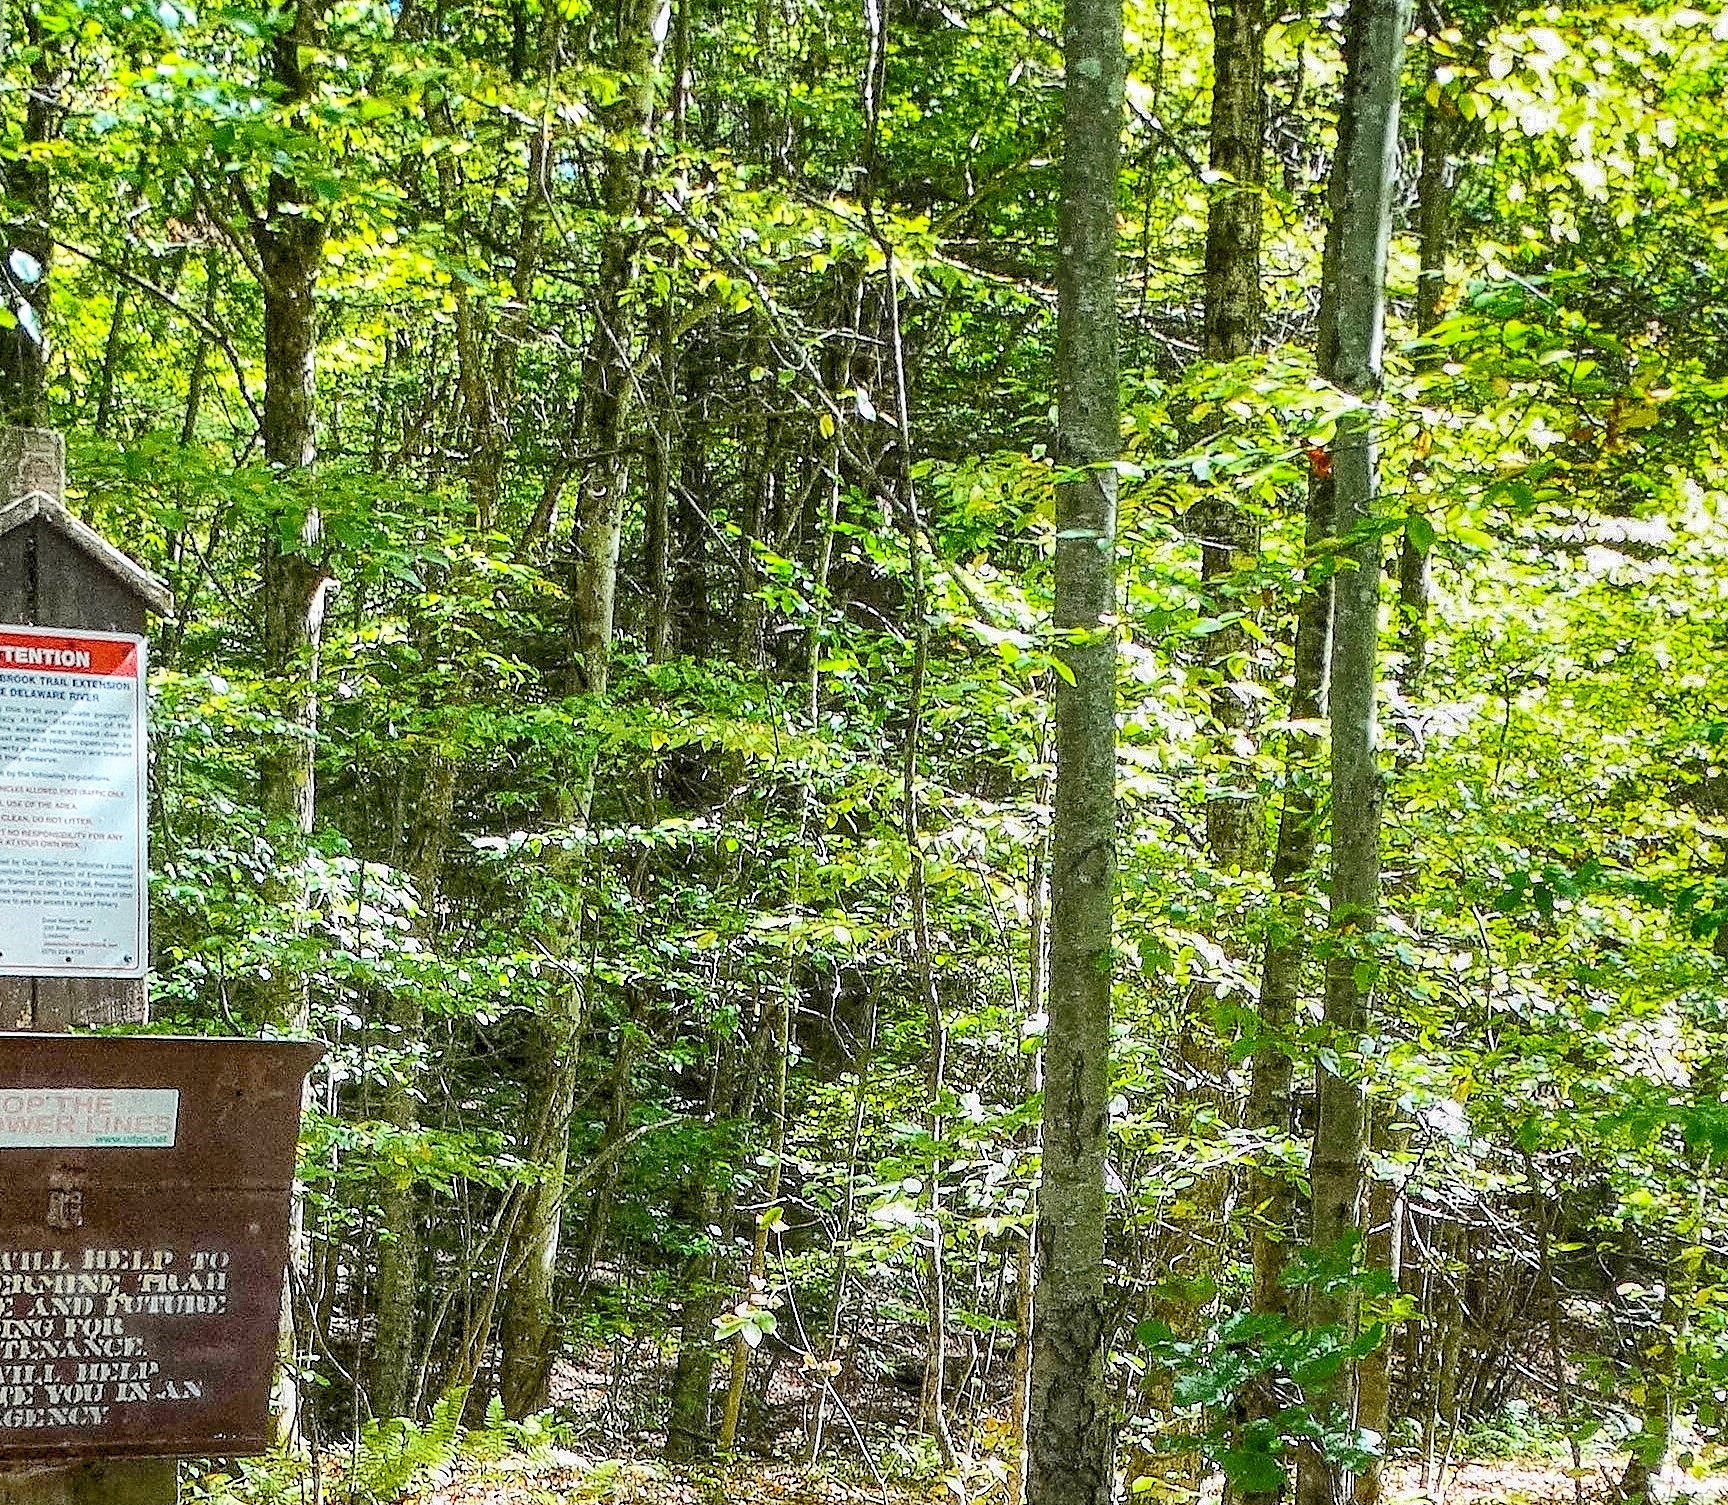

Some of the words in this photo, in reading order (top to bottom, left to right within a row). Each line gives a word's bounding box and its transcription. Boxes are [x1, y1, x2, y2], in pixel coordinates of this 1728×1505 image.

[0, 674, 36, 685] BROOK
[40, 677, 68, 687] TRAIL
[72, 679, 131, 691] EXTENSION
[11, 689, 66, 701] DELAWARE
[69, 693, 100, 702] RIVER
[55, 1096, 114, 1114] THE
[86, 1114, 172, 1133] LINES
[80, 1248, 174, 1271] HELP
[190, 1250, 230, 1271] TO
[28, 1296, 94, 1316] AND
[105, 1290, 228, 1316] FUTURE
[63, 1317, 124, 1340] FOR
[75, 1361, 161, 1383] HELP
[44, 1383, 106, 1405] YOU
[116, 1382, 152, 1402] IN
[156, 1379, 204, 1400] AN
